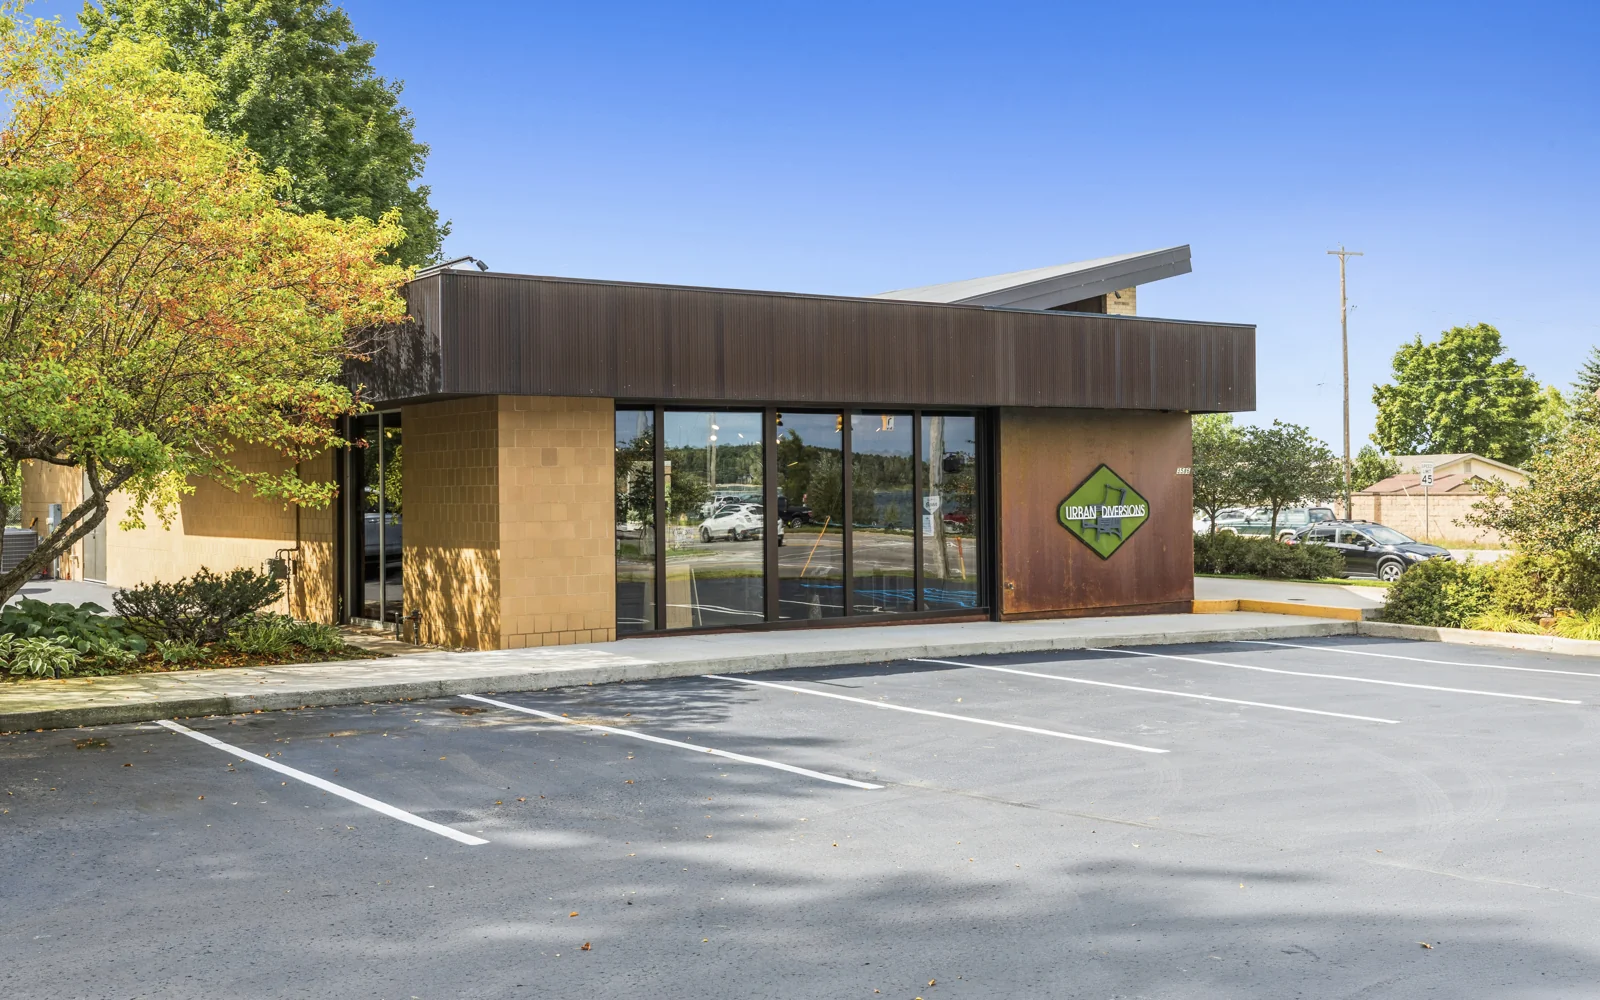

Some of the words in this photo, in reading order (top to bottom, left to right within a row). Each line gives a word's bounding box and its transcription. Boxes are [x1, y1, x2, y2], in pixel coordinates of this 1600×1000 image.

[1421, 474, 1433, 484] 45
[1065, 505, 1097, 520] URBAN
[1101, 504, 1146, 519] DIVERSIONS
